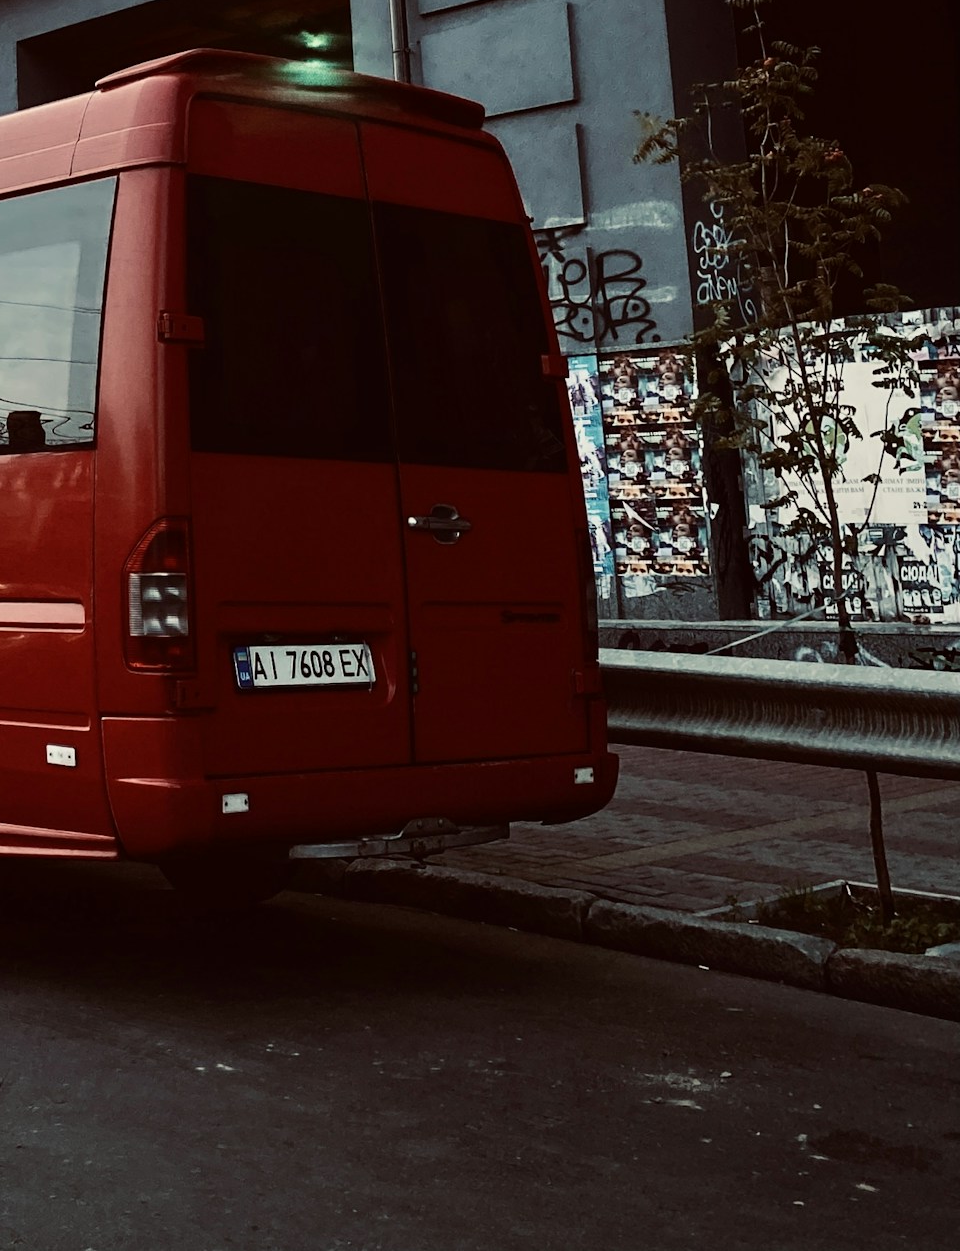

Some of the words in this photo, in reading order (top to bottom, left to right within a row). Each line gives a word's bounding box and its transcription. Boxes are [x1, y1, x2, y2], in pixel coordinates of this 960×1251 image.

[254, 651, 278, 680] AI
[285, 650, 336, 679] 7608
[338, 649, 369, 677] EX
[239, 672, 251, 681] UA
